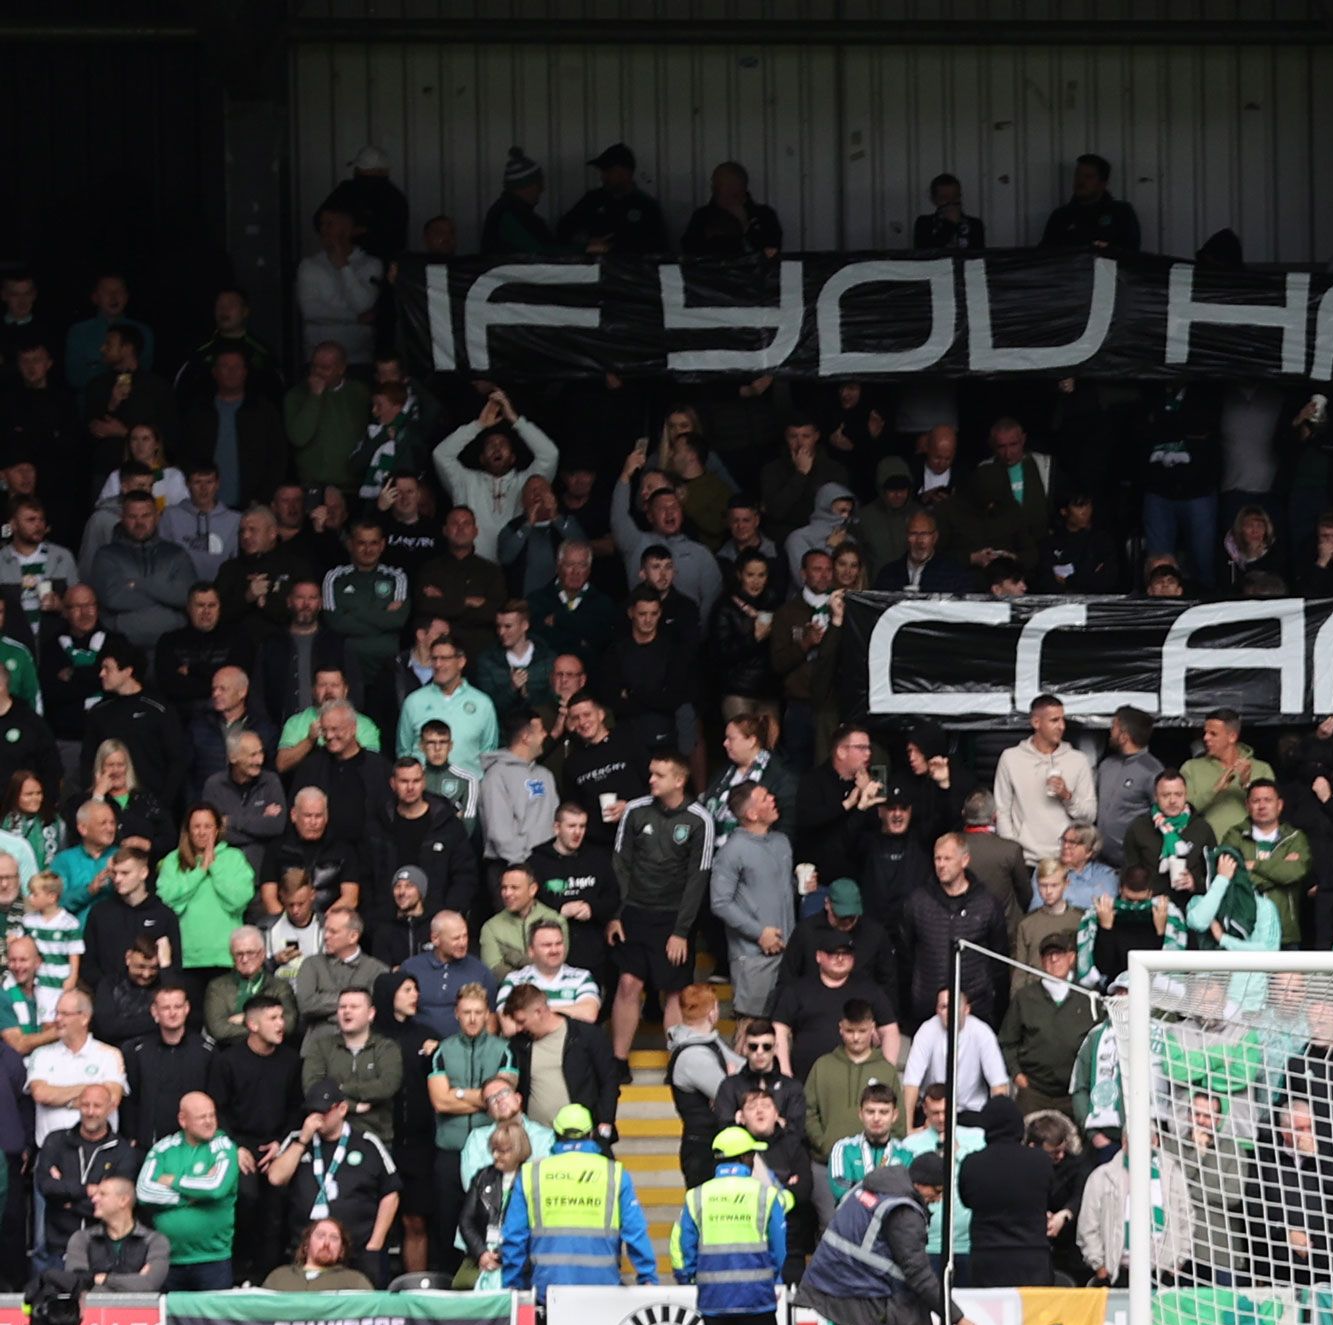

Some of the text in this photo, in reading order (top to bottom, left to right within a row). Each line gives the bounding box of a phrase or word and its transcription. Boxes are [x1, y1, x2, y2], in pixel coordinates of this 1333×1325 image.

[426, 261, 600, 371] IF
[659, 257, 1119, 377] YOU
[544, 1195, 602, 1208] STEWARD
[708, 1213, 752, 1222] STEWARD
